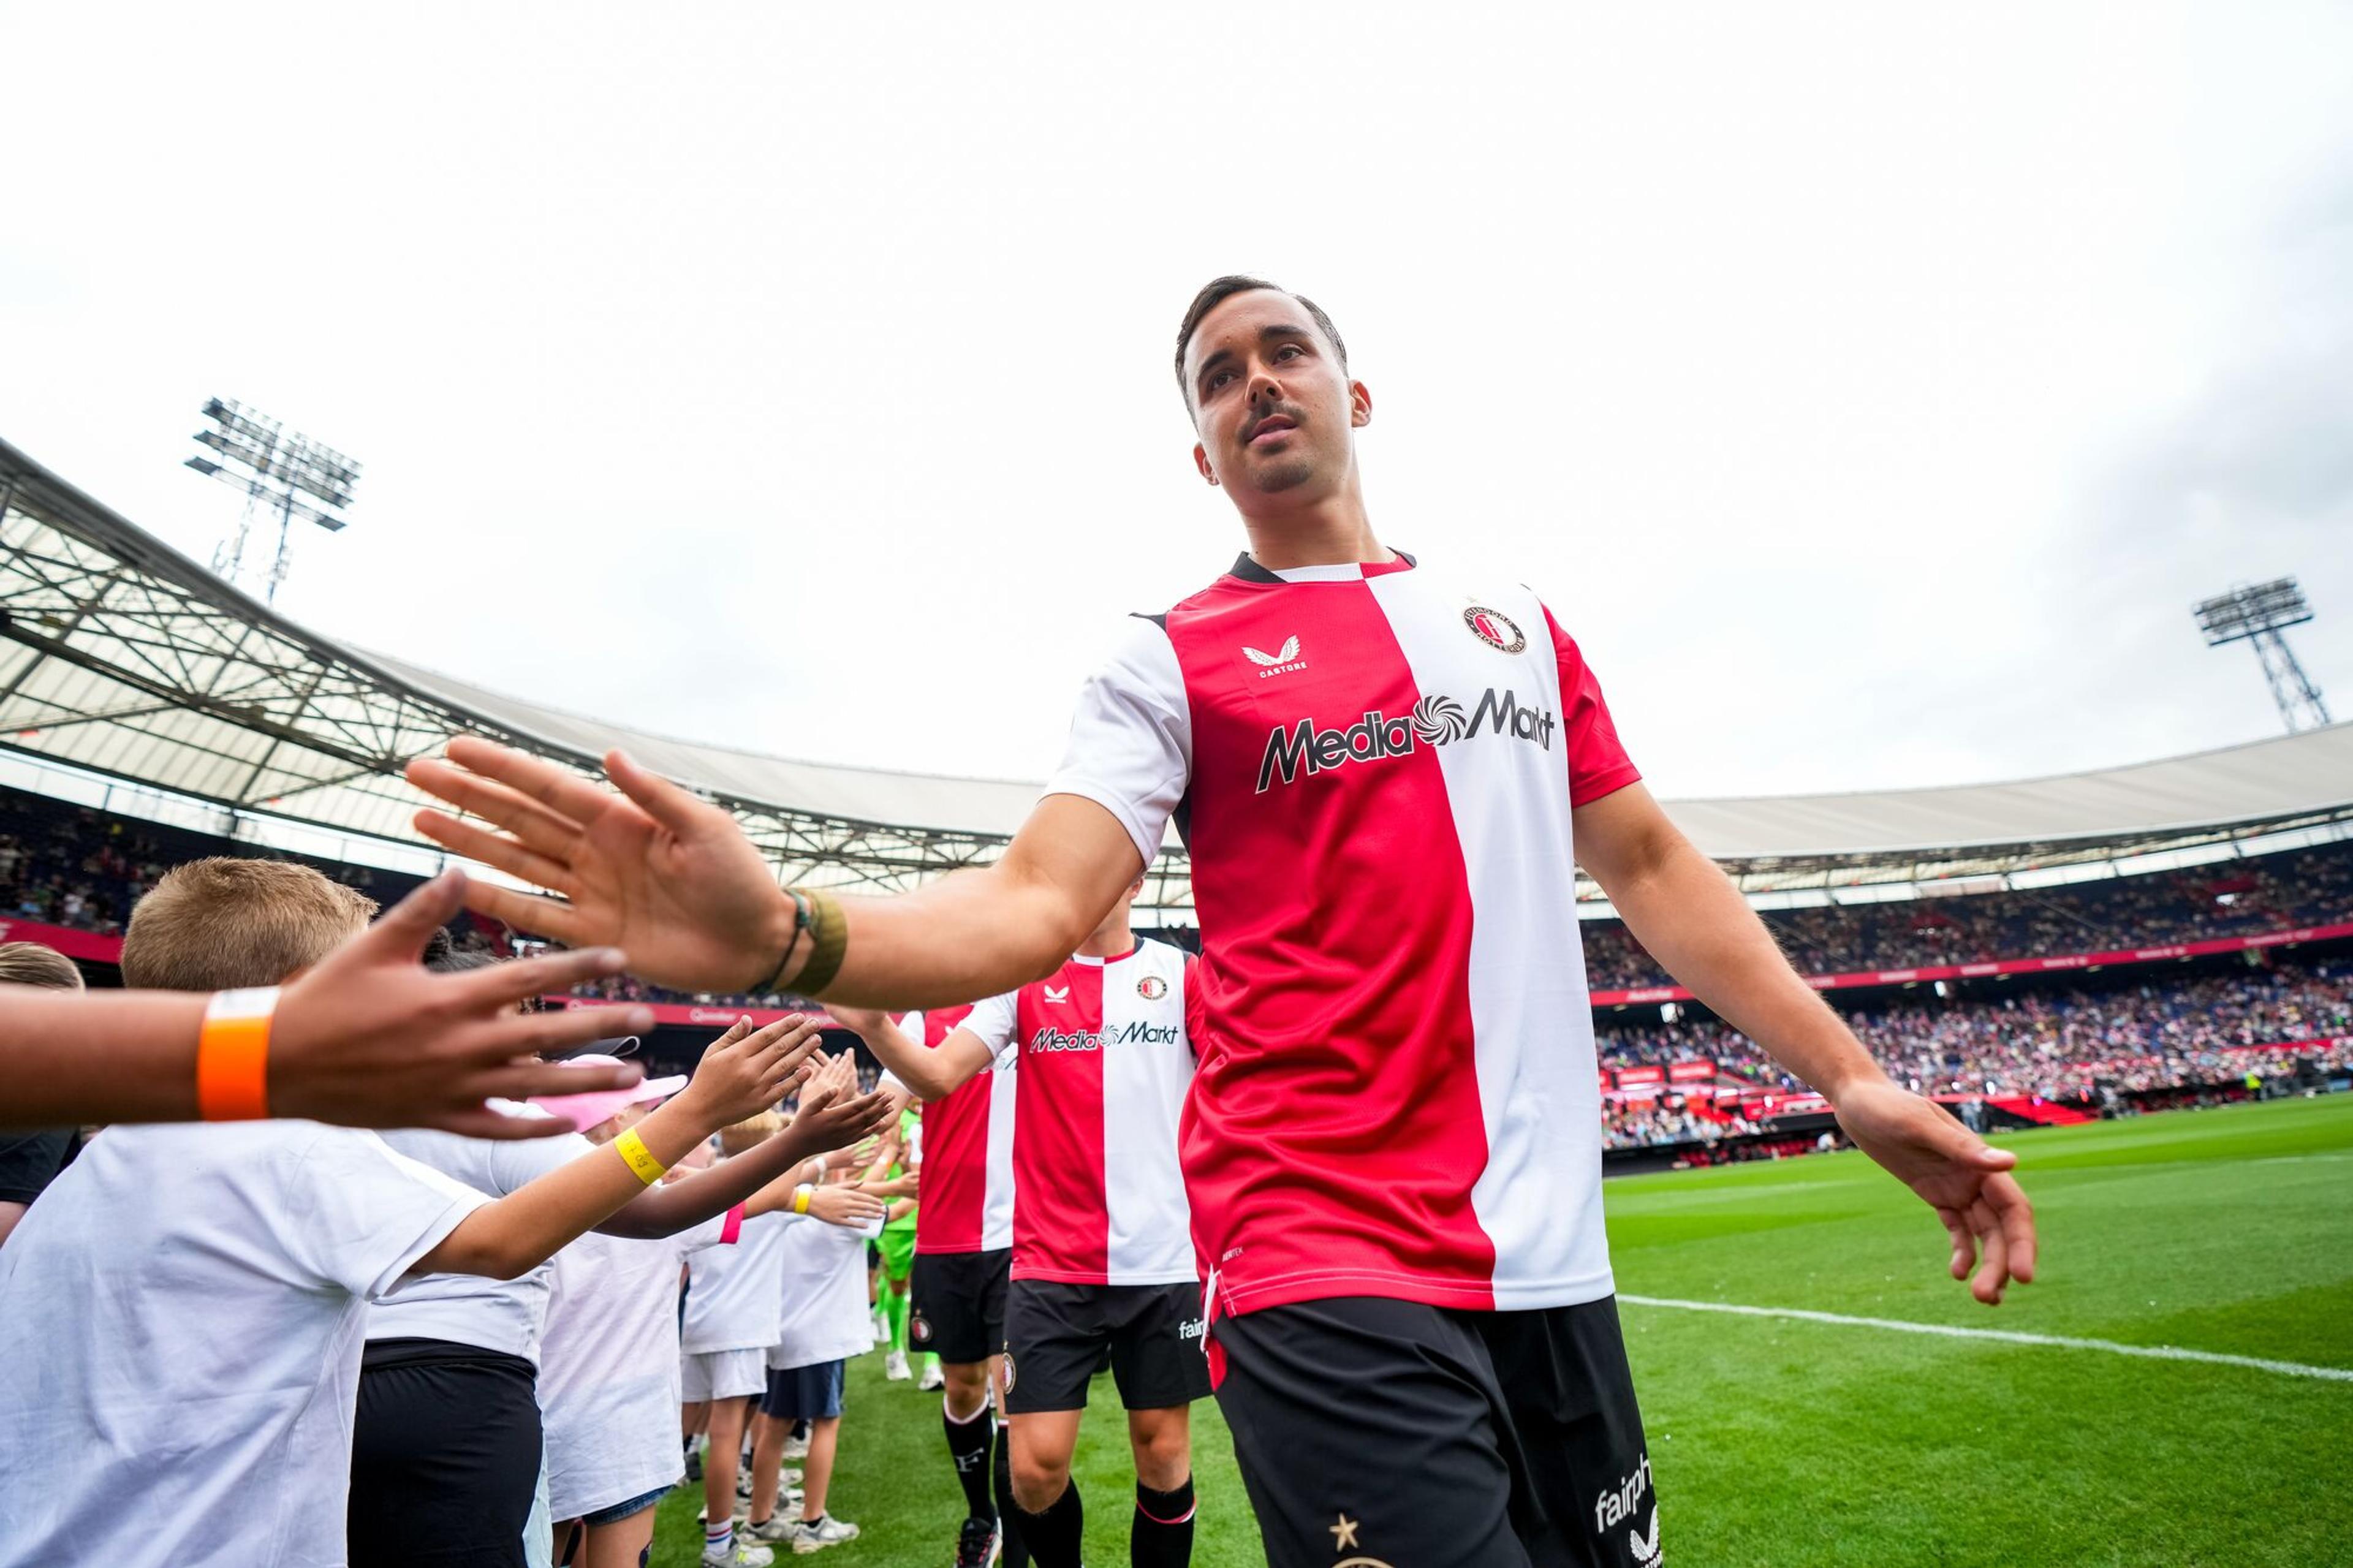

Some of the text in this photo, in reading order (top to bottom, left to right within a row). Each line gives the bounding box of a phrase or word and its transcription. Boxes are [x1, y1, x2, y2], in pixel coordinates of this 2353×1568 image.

[1259, 661, 1308, 679] CASTORE
[1256, 688, 1555, 794] Media Markt
[1029, 1021, 1178, 1053] Media Markt
